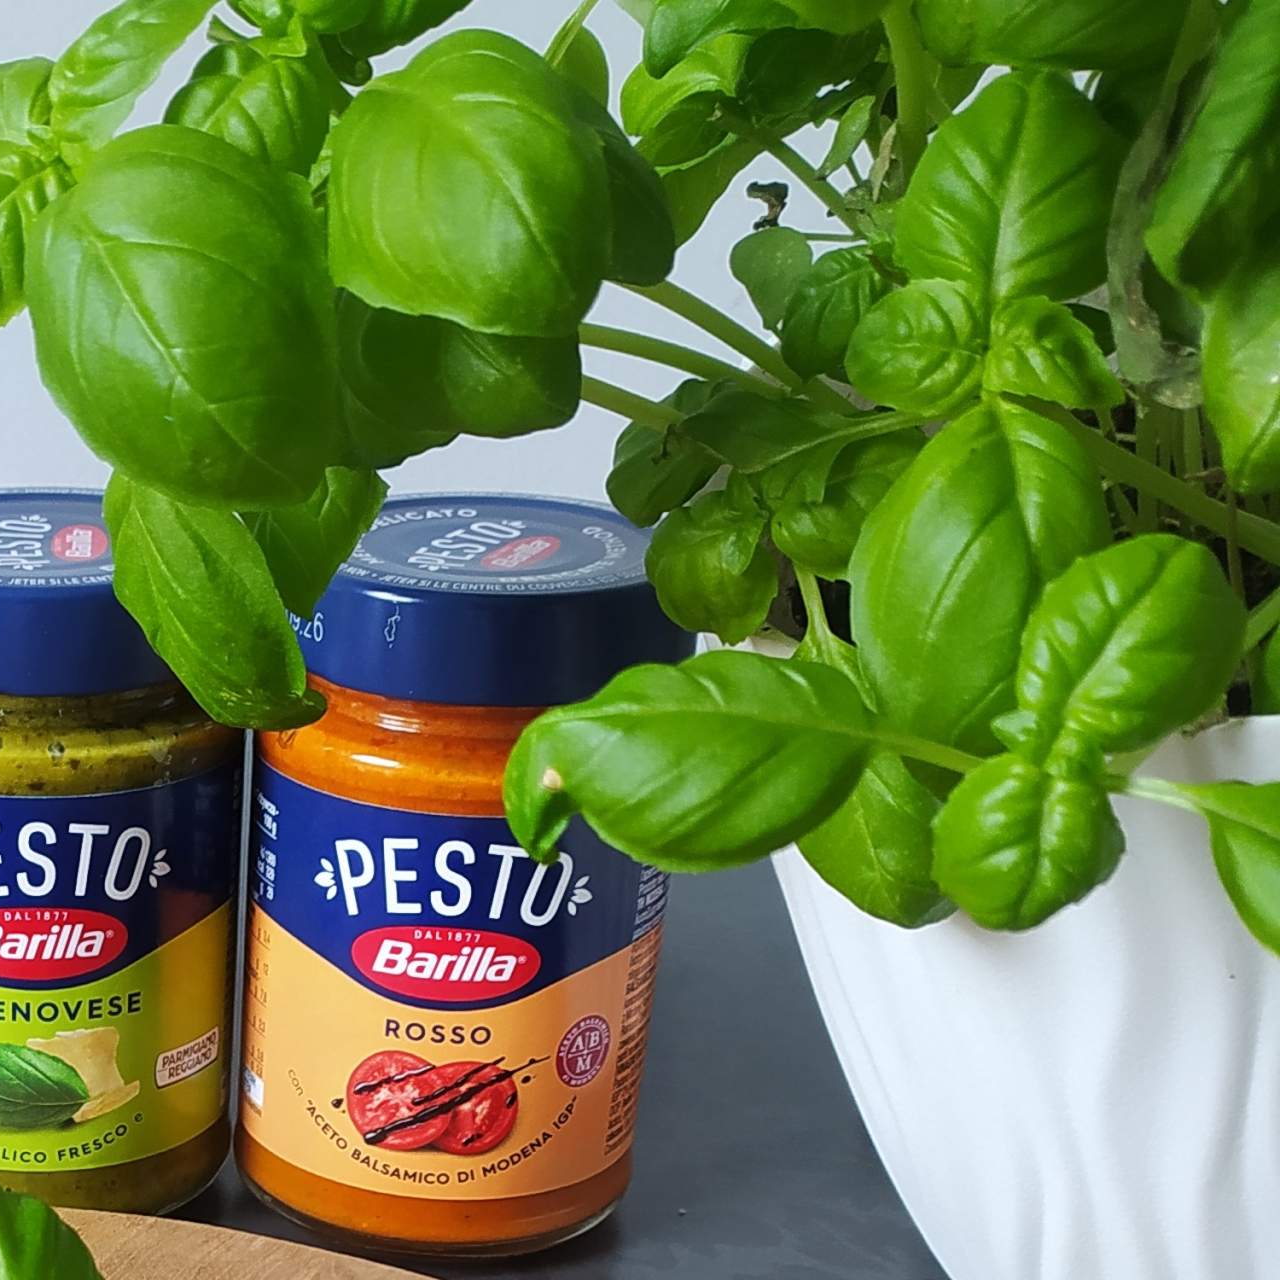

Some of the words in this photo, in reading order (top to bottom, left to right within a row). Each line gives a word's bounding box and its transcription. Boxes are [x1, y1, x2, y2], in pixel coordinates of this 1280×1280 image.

[407, 521, 522, 568] PESTO
[7, 577, 46, 585] JETER
[49, 577, 61, 585] SI
[65, 577, 79, 585] LE
[81, 575, 114, 584] CENT
[378, 573, 416, 585] JETER
[433, 581, 449, 589] LE
[452, 582, 504, 591] CENTRE
[506, 583, 525, 591] DU
[334, 838, 574, 926] PESTO
[3, 912, 32, 922] DAL
[35, 911, 69, 921] 1877
[414, 930, 443, 940] DAL
[447, 932, 481, 943] 1877
[385, 1018, 491, 1045] ROSSO
[57, 1123, 129, 1161] FRESCO
[134, 1111, 144, 1123] e
[287, 1068, 305, 1097] con
[351, 1148, 450, 1185] BALSAMICO
[457, 1169, 475, 1183] DI
[481, 1130, 553, 1177] MODENA
